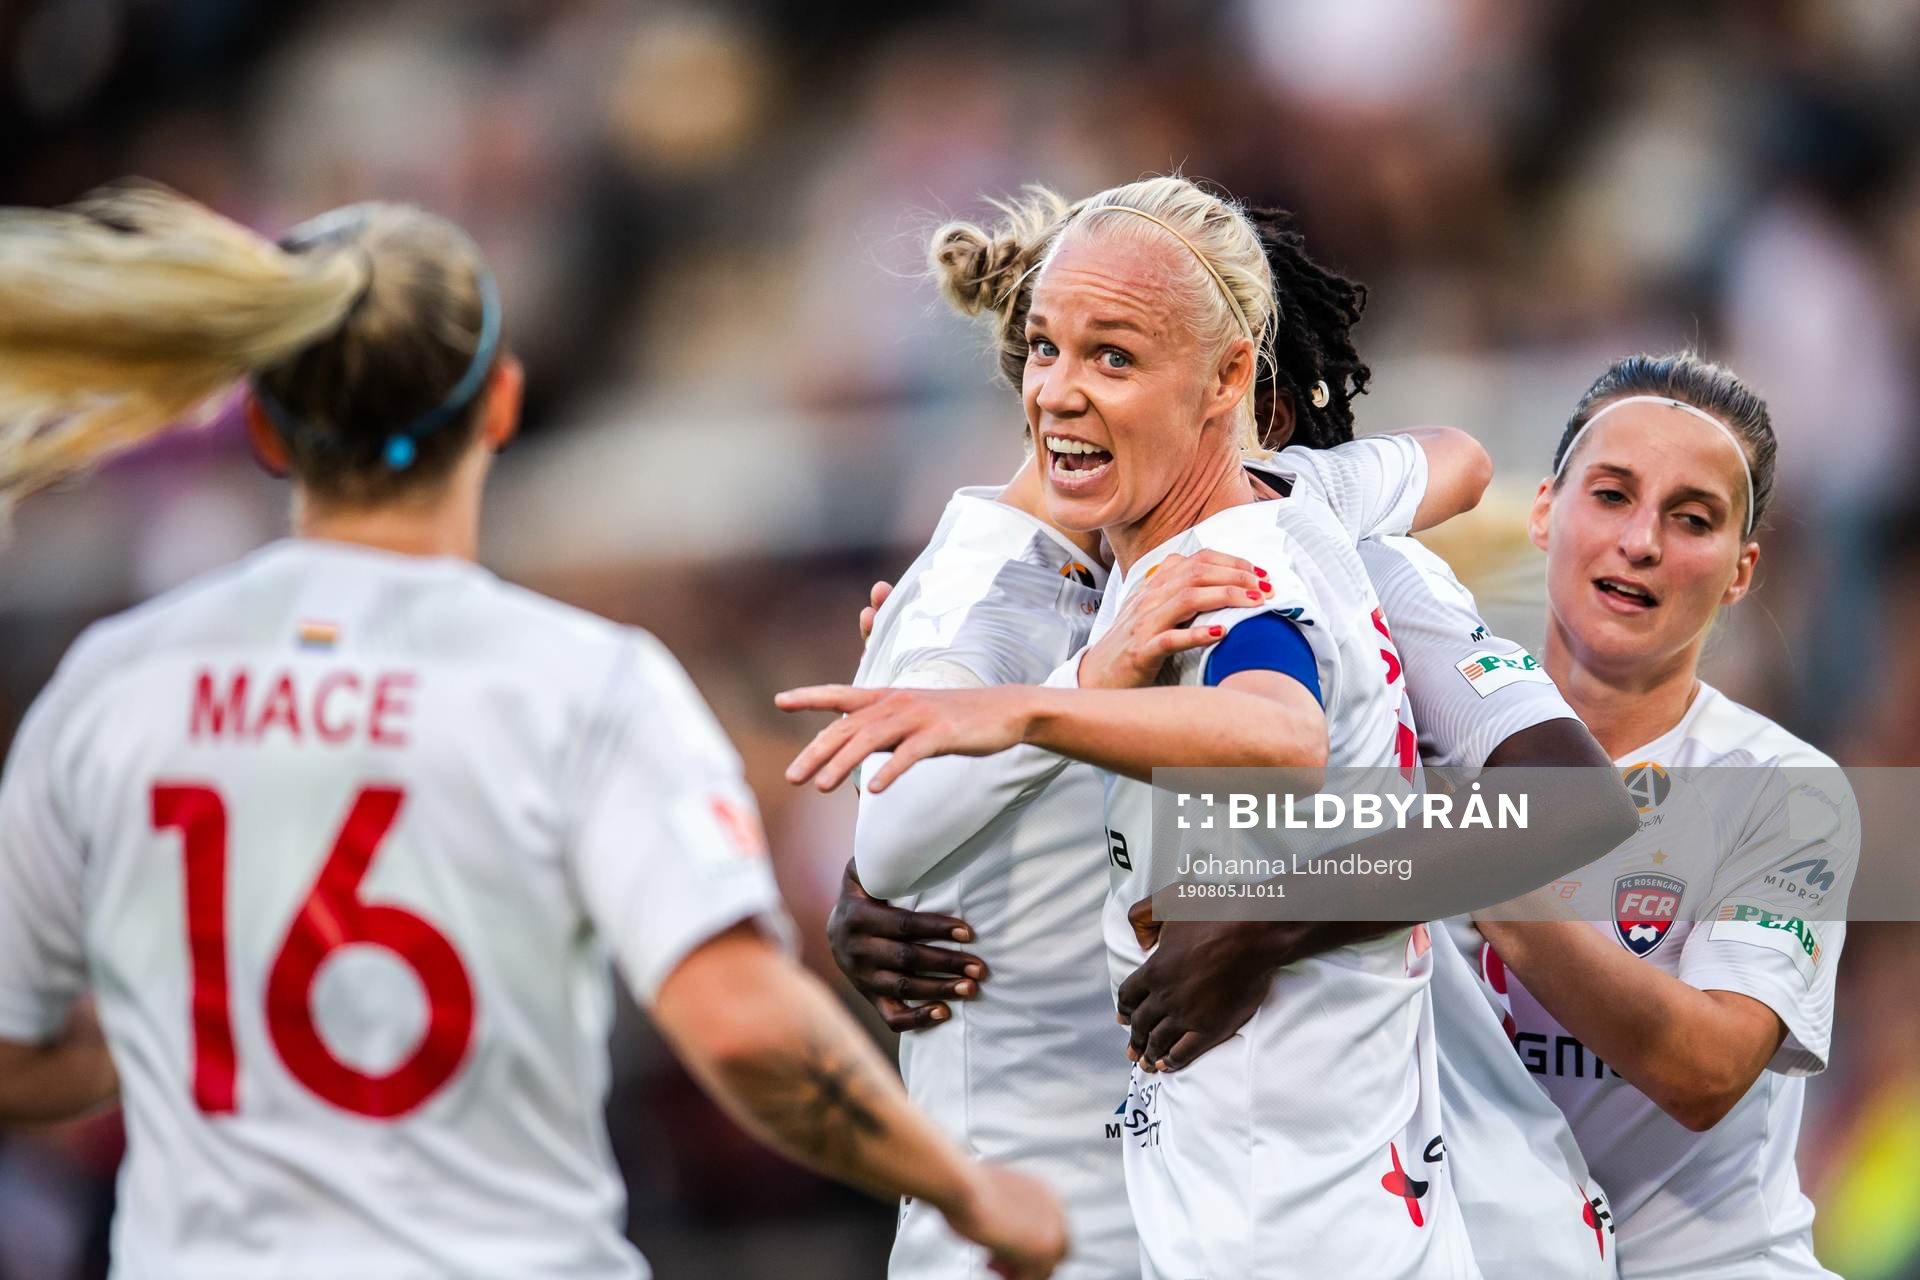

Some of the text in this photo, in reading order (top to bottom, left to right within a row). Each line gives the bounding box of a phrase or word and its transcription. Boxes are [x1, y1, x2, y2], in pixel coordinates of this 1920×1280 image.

[1476, 654, 1540, 673] PEA
[187, 666, 418, 745] MACE
[1621, 893, 1677, 917] FCR
[1622, 878, 1682, 894] FC ROSENGÅRD
[1731, 904, 1815, 956] PEAB
[149, 781, 477, 1124] 16
